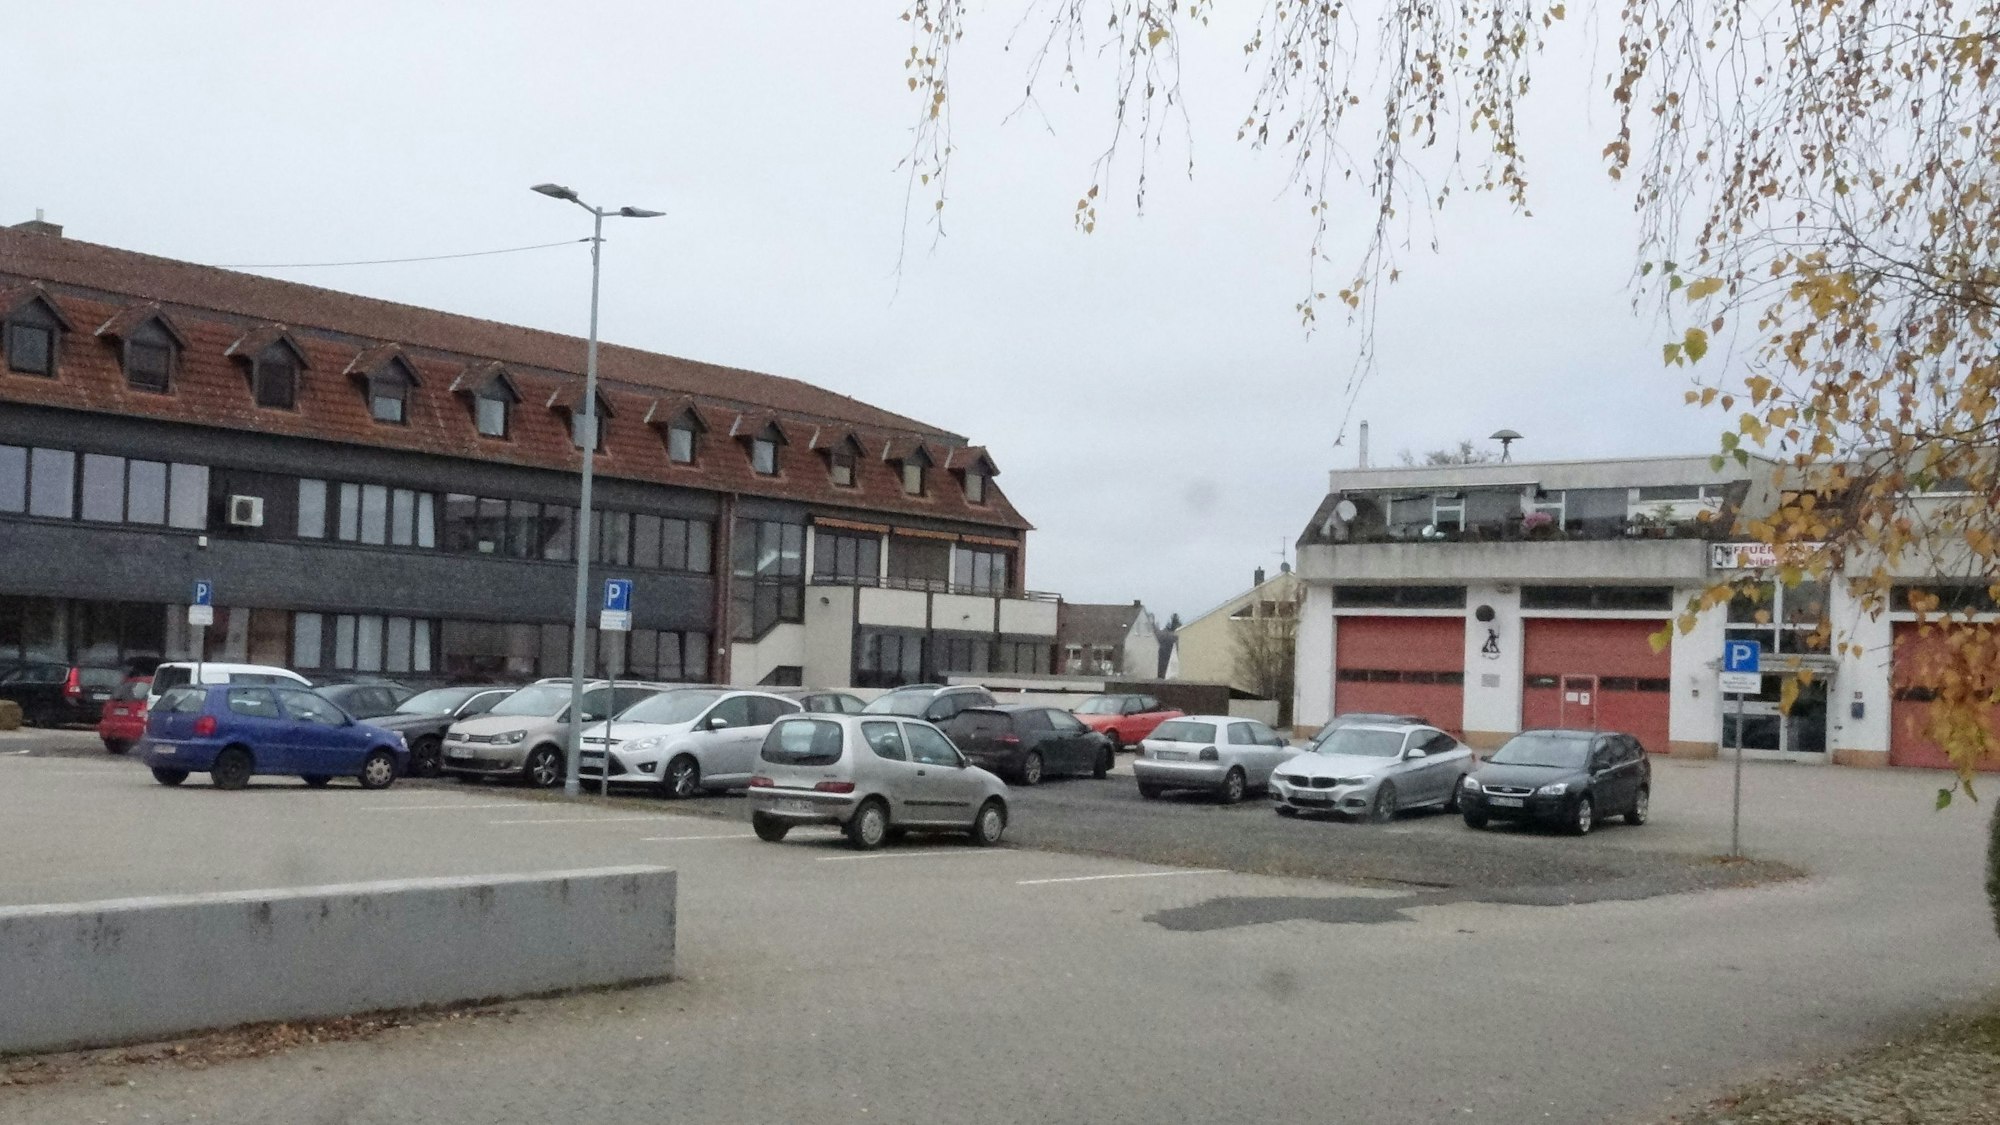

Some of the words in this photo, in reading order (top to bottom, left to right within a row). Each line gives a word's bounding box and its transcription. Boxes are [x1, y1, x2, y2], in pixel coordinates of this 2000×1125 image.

[197, 583, 207, 603] P
[608, 583, 621, 606] P
[1732, 644, 1751, 668] P
